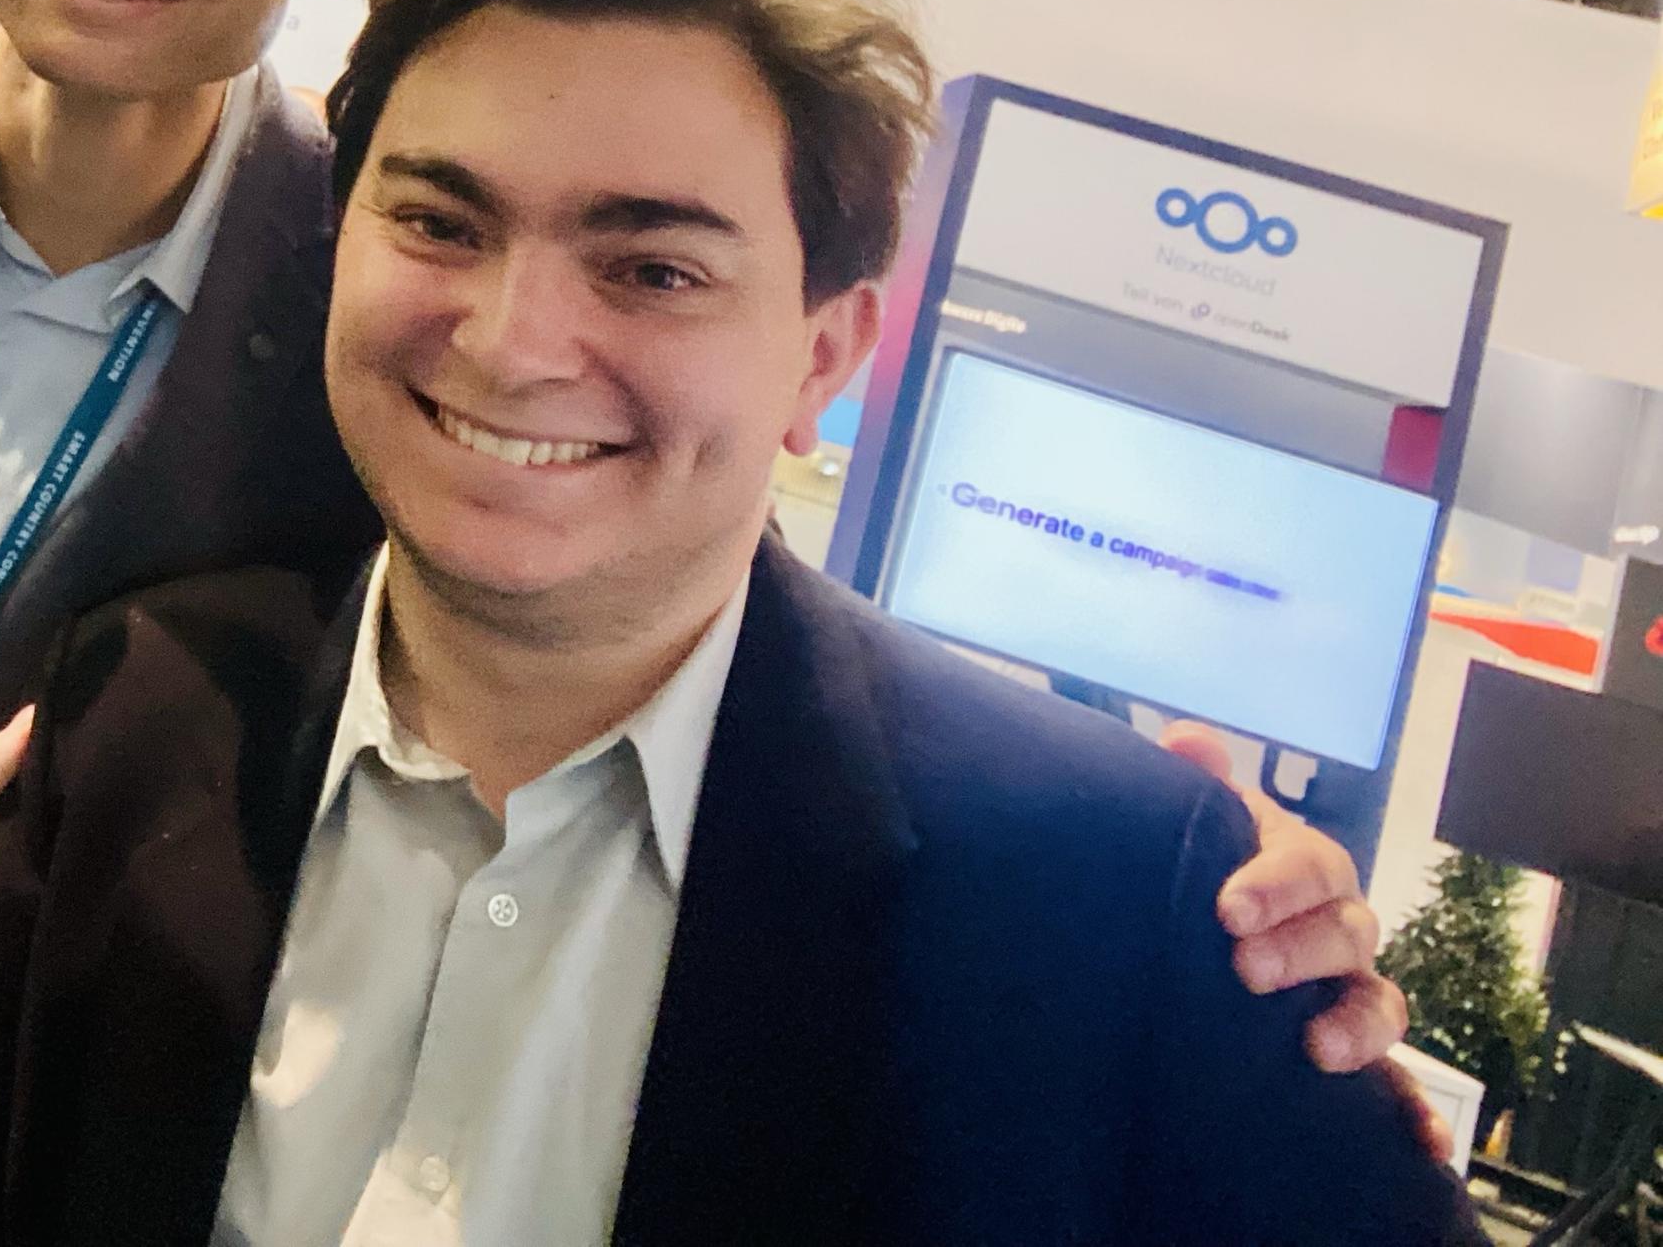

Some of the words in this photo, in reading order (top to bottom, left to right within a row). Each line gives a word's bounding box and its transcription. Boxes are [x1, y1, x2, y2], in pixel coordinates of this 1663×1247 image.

[1155, 243, 1277, 296] Nextcloud
[52, 431, 86, 483] SMART
[15, 482, 57, 549] COUNTRY
[951, 482, 1086, 542] Generate
[1089, 531, 1105, 549] a
